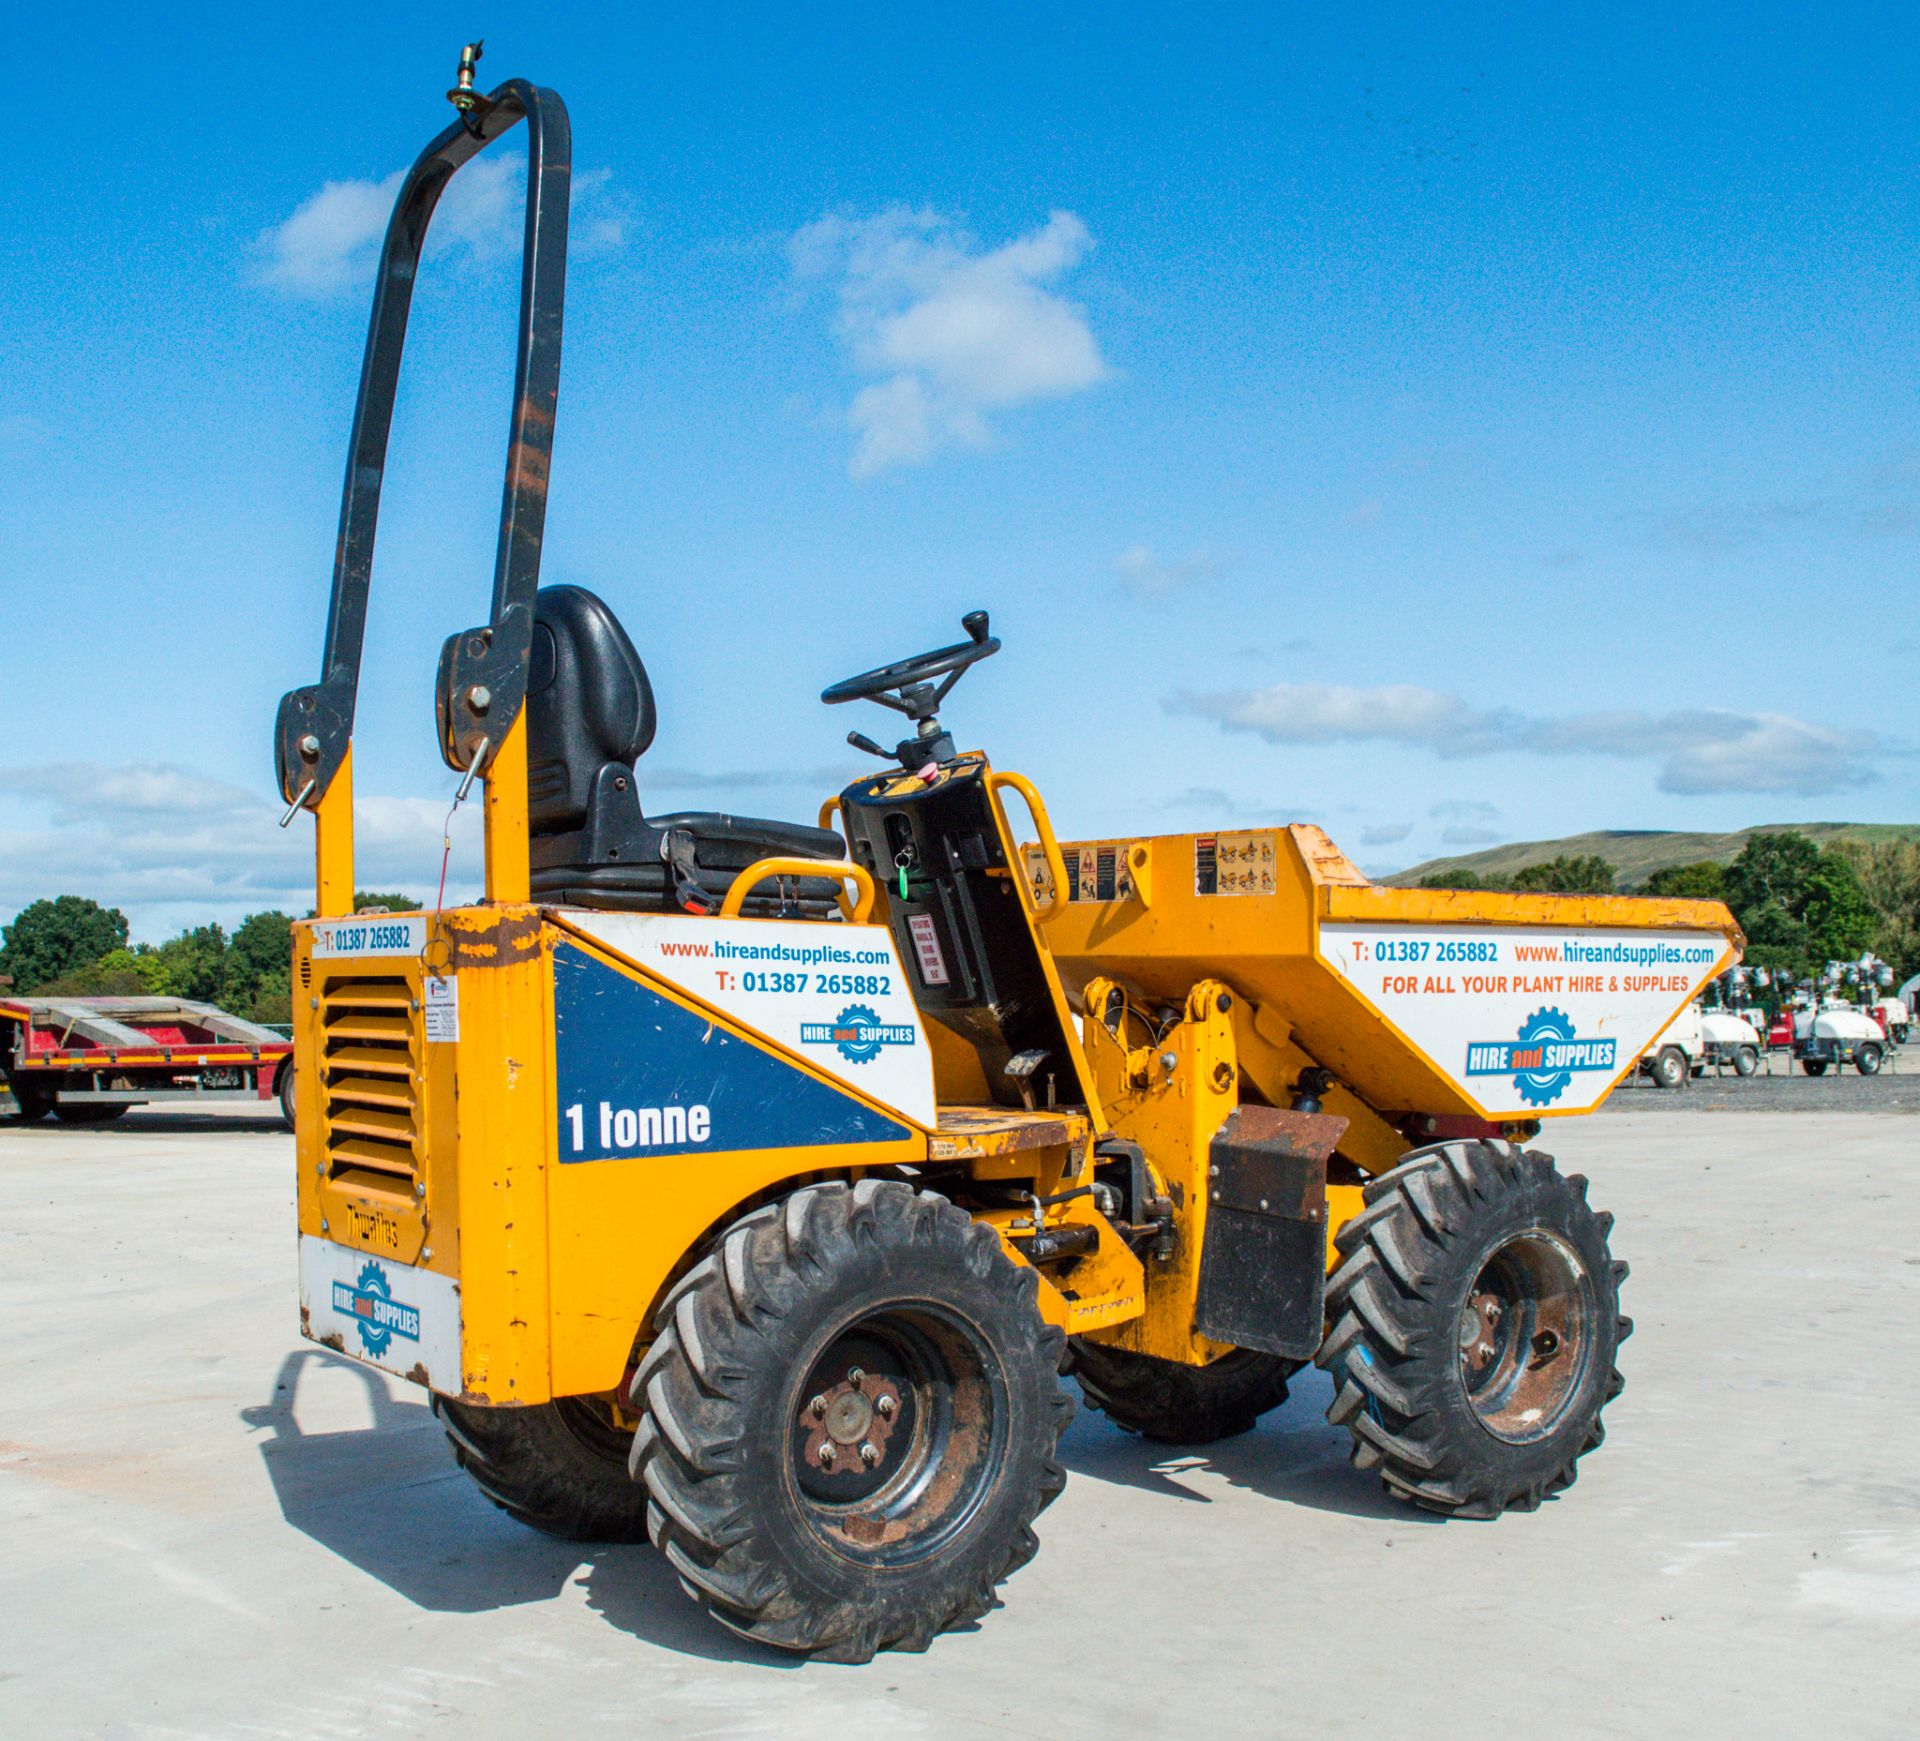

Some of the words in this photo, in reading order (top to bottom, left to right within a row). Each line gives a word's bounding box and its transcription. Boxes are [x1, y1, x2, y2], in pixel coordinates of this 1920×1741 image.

[324, 931, 334, 951] T:
[335, 928, 367, 951] 01387
[369, 925, 411, 949] 265882
[660, 941, 890, 966] www.hireandsupplies.com
[1352, 941, 1369, 961] T:
[1375, 941, 1431, 962] 01387
[1435, 942, 1498, 962] 265882
[1514, 941, 1714, 967] www.hireandsupplies.com
[715, 971, 736, 991] T:
[742, 972, 808, 993] 01387
[815, 974, 891, 996] 265882
[1382, 976, 1418, 994] FOR
[1423, 976, 1456, 994] ALL
[1462, 976, 1508, 994] YOUR
[1512, 976, 1564, 993] PLANT
[1568, 976, 1604, 993] HIRE
[1608, 976, 1619, 992] &
[1623, 976, 1689, 992] SUPPLIES
[802, 1026, 831, 1041] HIRE
[833, 1027, 857, 1041] and
[859, 1027, 914, 1043] SUPPLIES
[1469, 1047, 1509, 1071] HIRE
[1511, 1046, 1543, 1069] and
[1545, 1043, 1614, 1068] SUPPLIES
[565, 1104, 584, 1151] 1
[600, 1101, 711, 1149] tonne
[347, 1203, 398, 1248] Thwaites
[333, 1285, 354, 1312] HIRE
[355, 1297, 373, 1319] and
[373, 1299, 419, 1336] SUPPLIES
